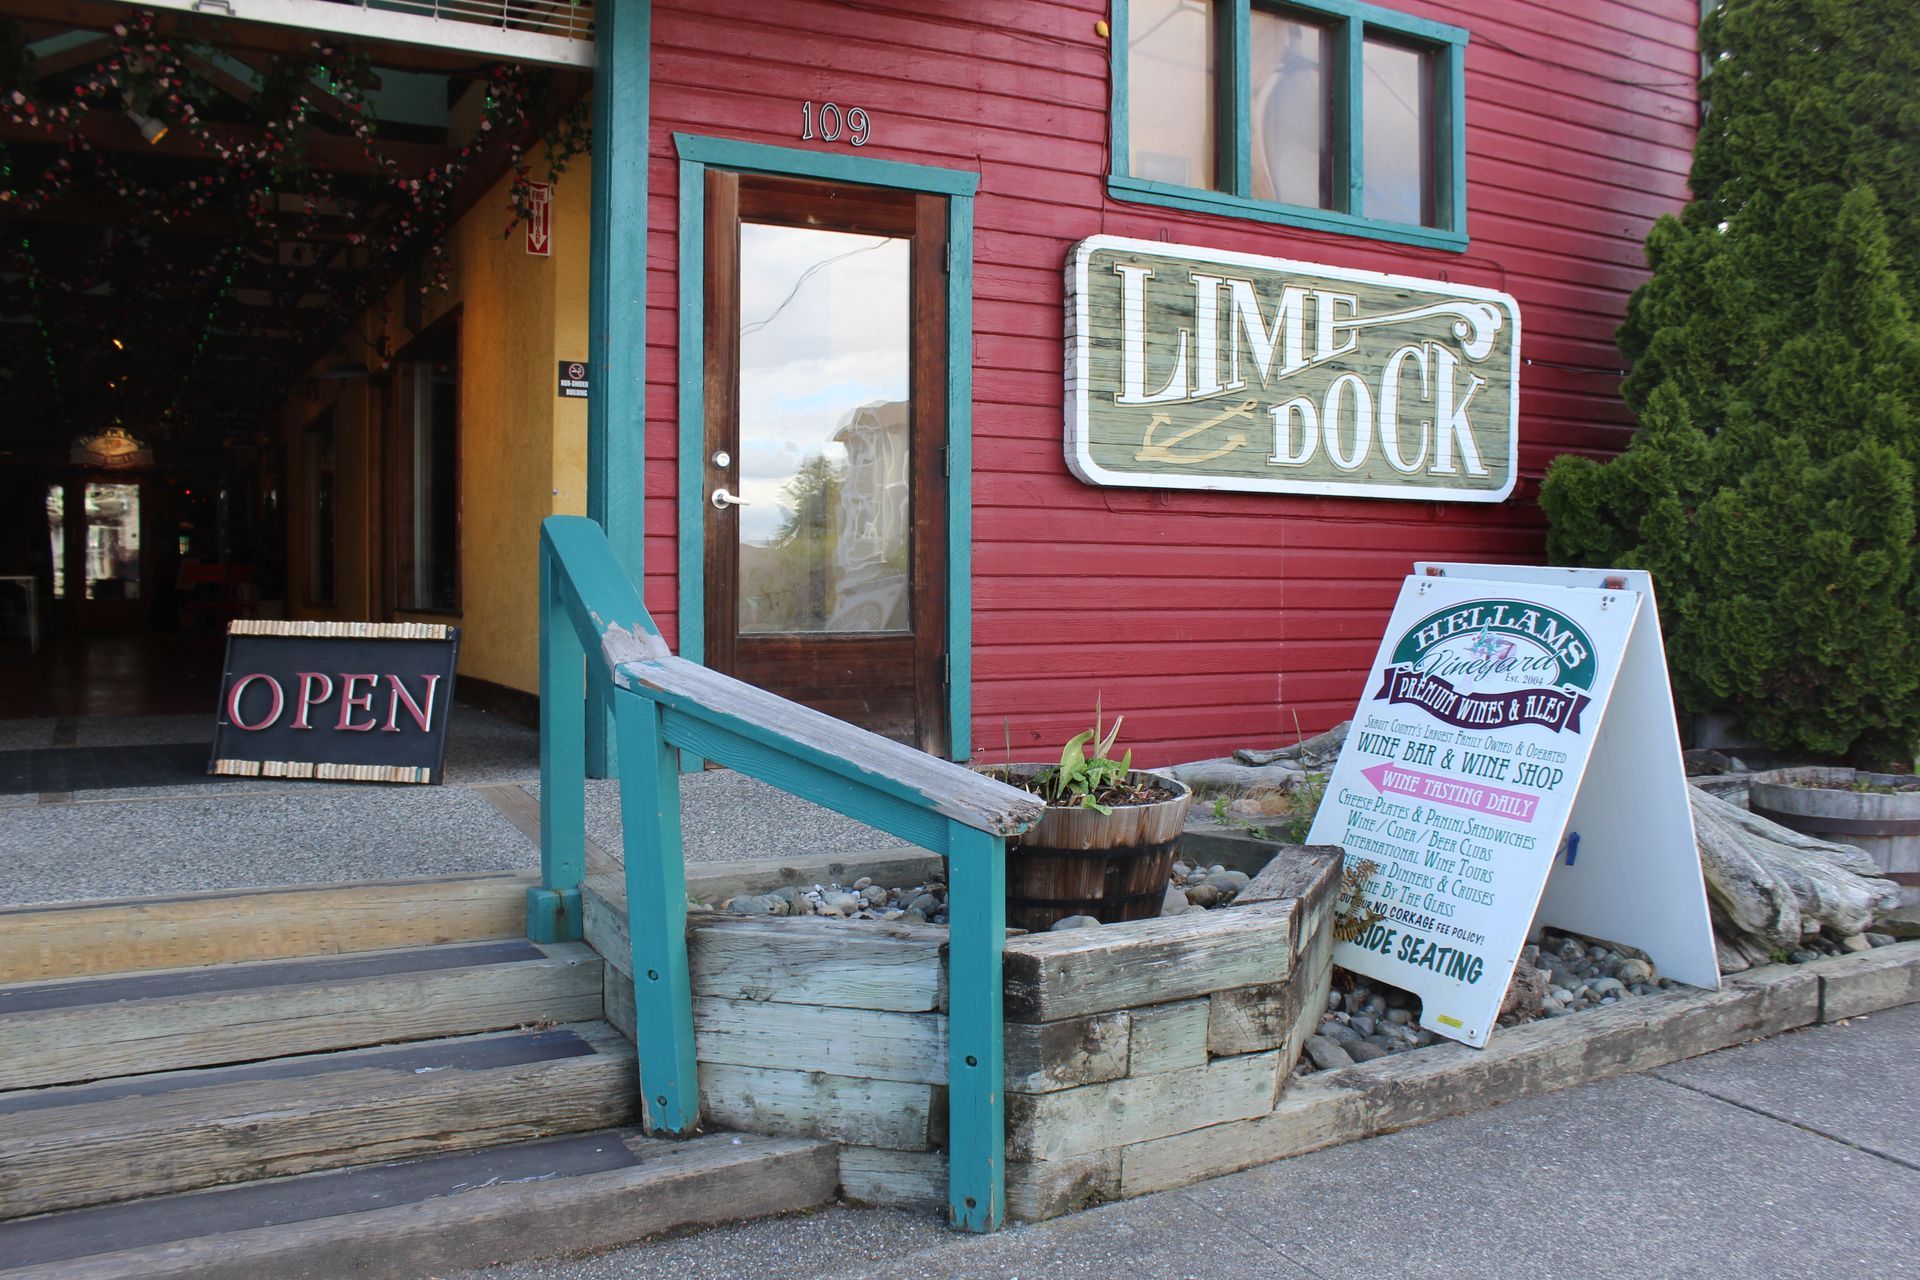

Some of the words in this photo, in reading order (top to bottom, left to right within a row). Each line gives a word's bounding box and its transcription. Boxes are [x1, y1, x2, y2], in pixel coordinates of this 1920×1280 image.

[802, 101, 871, 147] 109
[532, 191, 545, 201] FIRE
[1113, 261, 1502, 406] LIME
[1267, 341, 1491, 478] DOCK
[1413, 606, 1587, 669] HELLAMS
[1413, 649, 1567, 681] Vineyard
[1505, 673, 1519, 683] Est.
[1523, 675, 1543, 685] 2004
[227, 672, 440, 732] OPEN
[1398, 678, 1458, 715] PREMIUM
[1457, 697, 1504, 724] WINES
[1509, 699, 1519, 721] &
[1524, 695, 1564, 723] ALES
[1357, 731, 1400, 758] WINE
[1402, 741, 1437, 766] BAR
[1441, 748, 1455, 770] &
[1461, 752, 1511, 781] WINE
[1512, 762, 1563, 791] SHOP
[1515, 741, 1524, 756] &
[1382, 770, 1420, 792] WINE
[1424, 778, 1483, 807] TASTING
[1486, 794, 1534, 817] DAILY
[1411, 806, 1424, 823] &
[1437, 875, 1449, 893] &
[1373, 901, 1388, 915] NO
[1389, 906, 1435, 930] CORKAGE
[1435, 922, 1451, 935] FEE
[1451, 927, 1485, 946] POLICY!
[1397, 933, 1484, 984] SEATING
